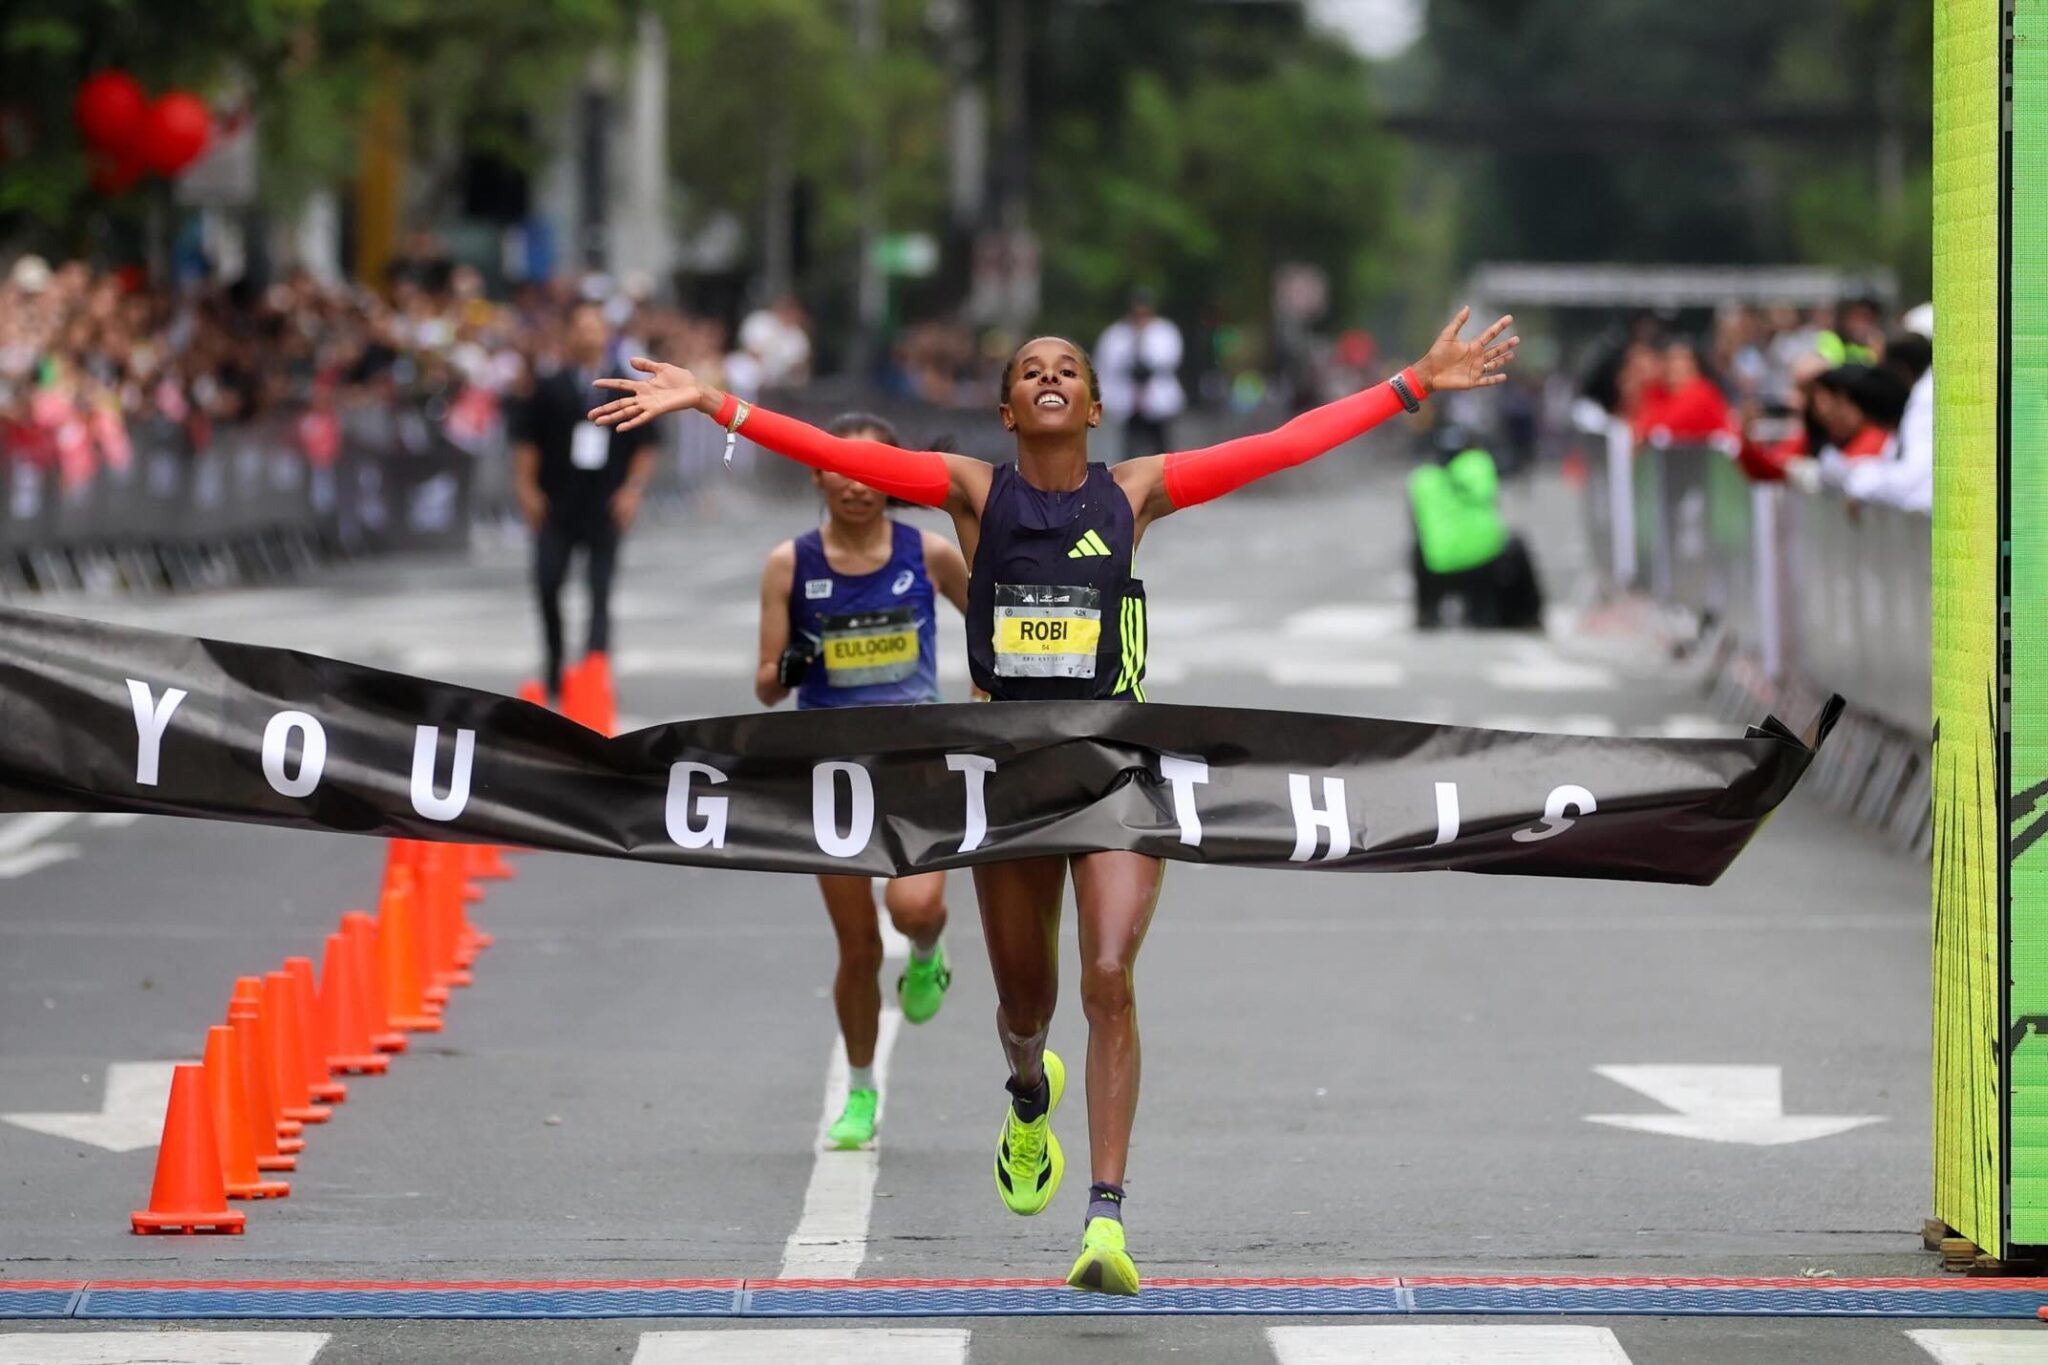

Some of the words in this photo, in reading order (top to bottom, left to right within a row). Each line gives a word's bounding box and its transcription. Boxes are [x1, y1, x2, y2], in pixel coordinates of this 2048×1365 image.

[1020, 620, 1067, 641] ROBI
[834, 636, 907, 659] EULOGIO
[125, 678, 476, 822] YOU
[664, 753, 997, 858] GOT
[1159, 755, 1597, 863] THIS
